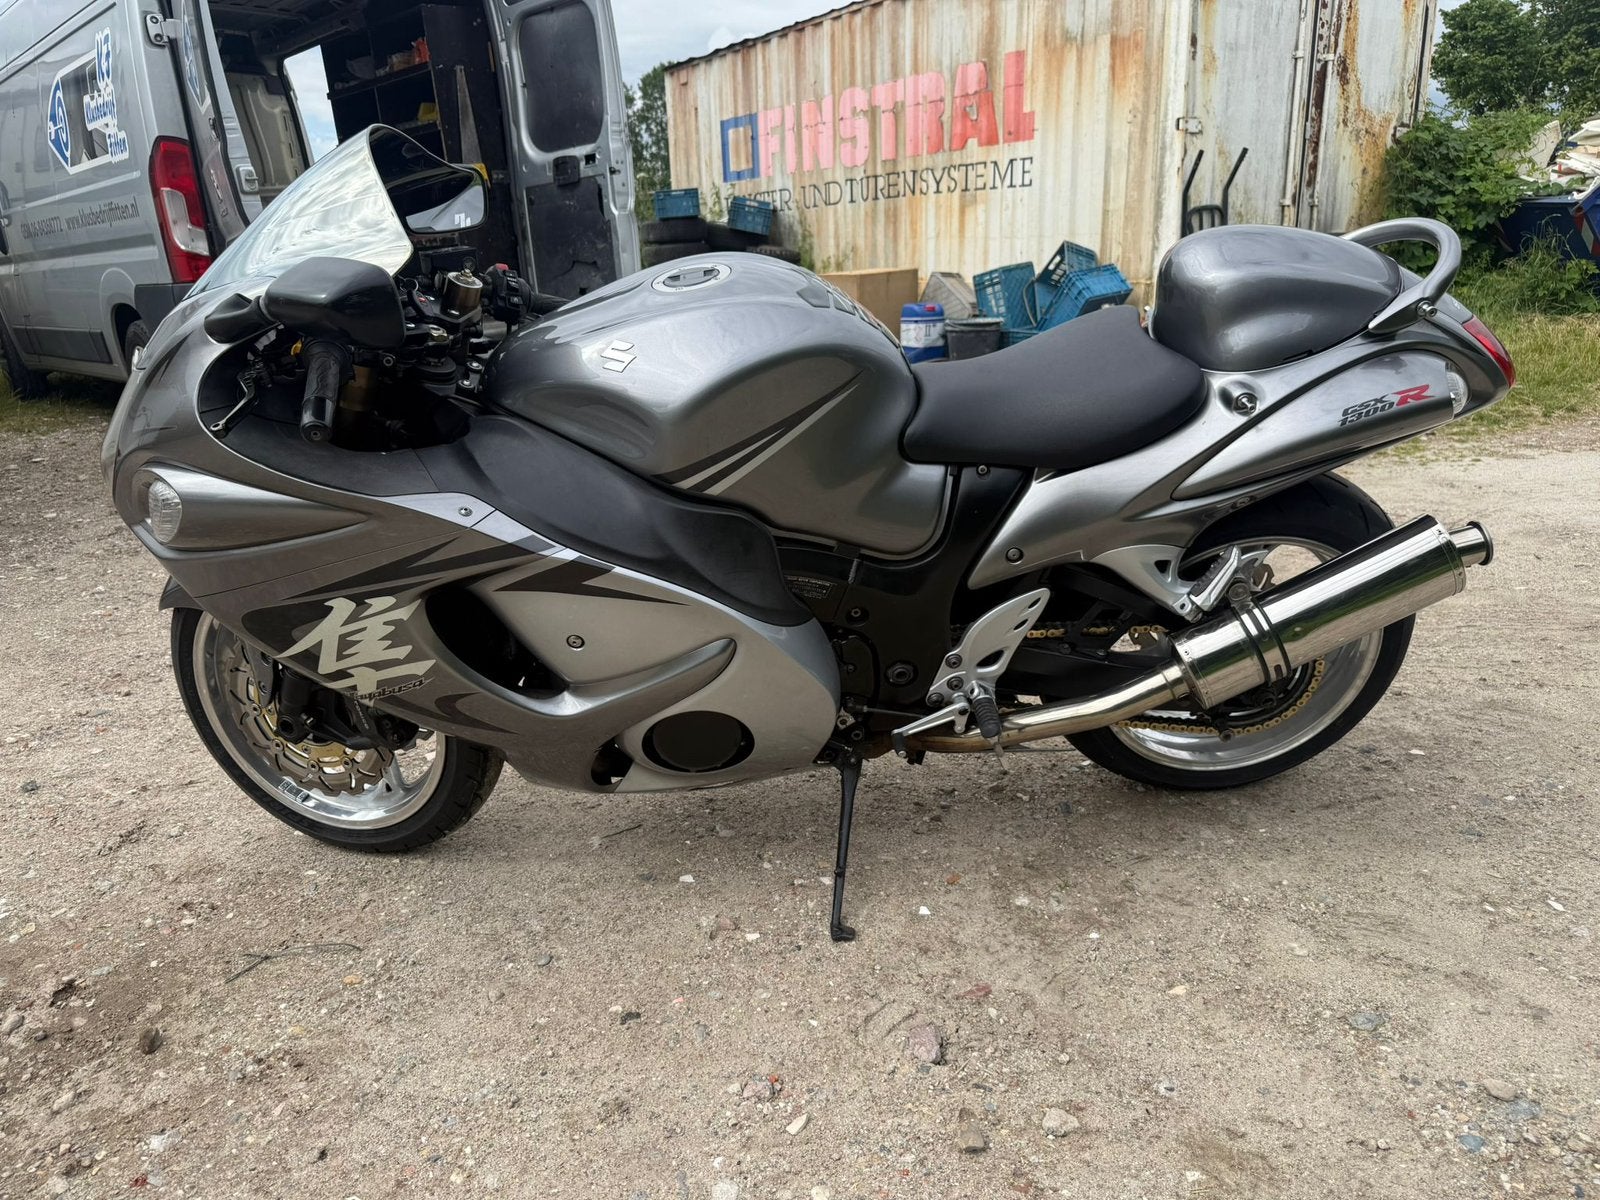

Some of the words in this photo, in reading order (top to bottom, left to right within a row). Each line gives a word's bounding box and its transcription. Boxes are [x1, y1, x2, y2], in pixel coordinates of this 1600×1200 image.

[757, 49, 1035, 178] FINSTRAL
[800, 180, 843, 210] UND
[1338, 402, 1395, 427] 1300
[1341, 394, 1391, 417] GSX
[1391, 384, 1435, 407] R
[275, 596, 437, 707] 隼
